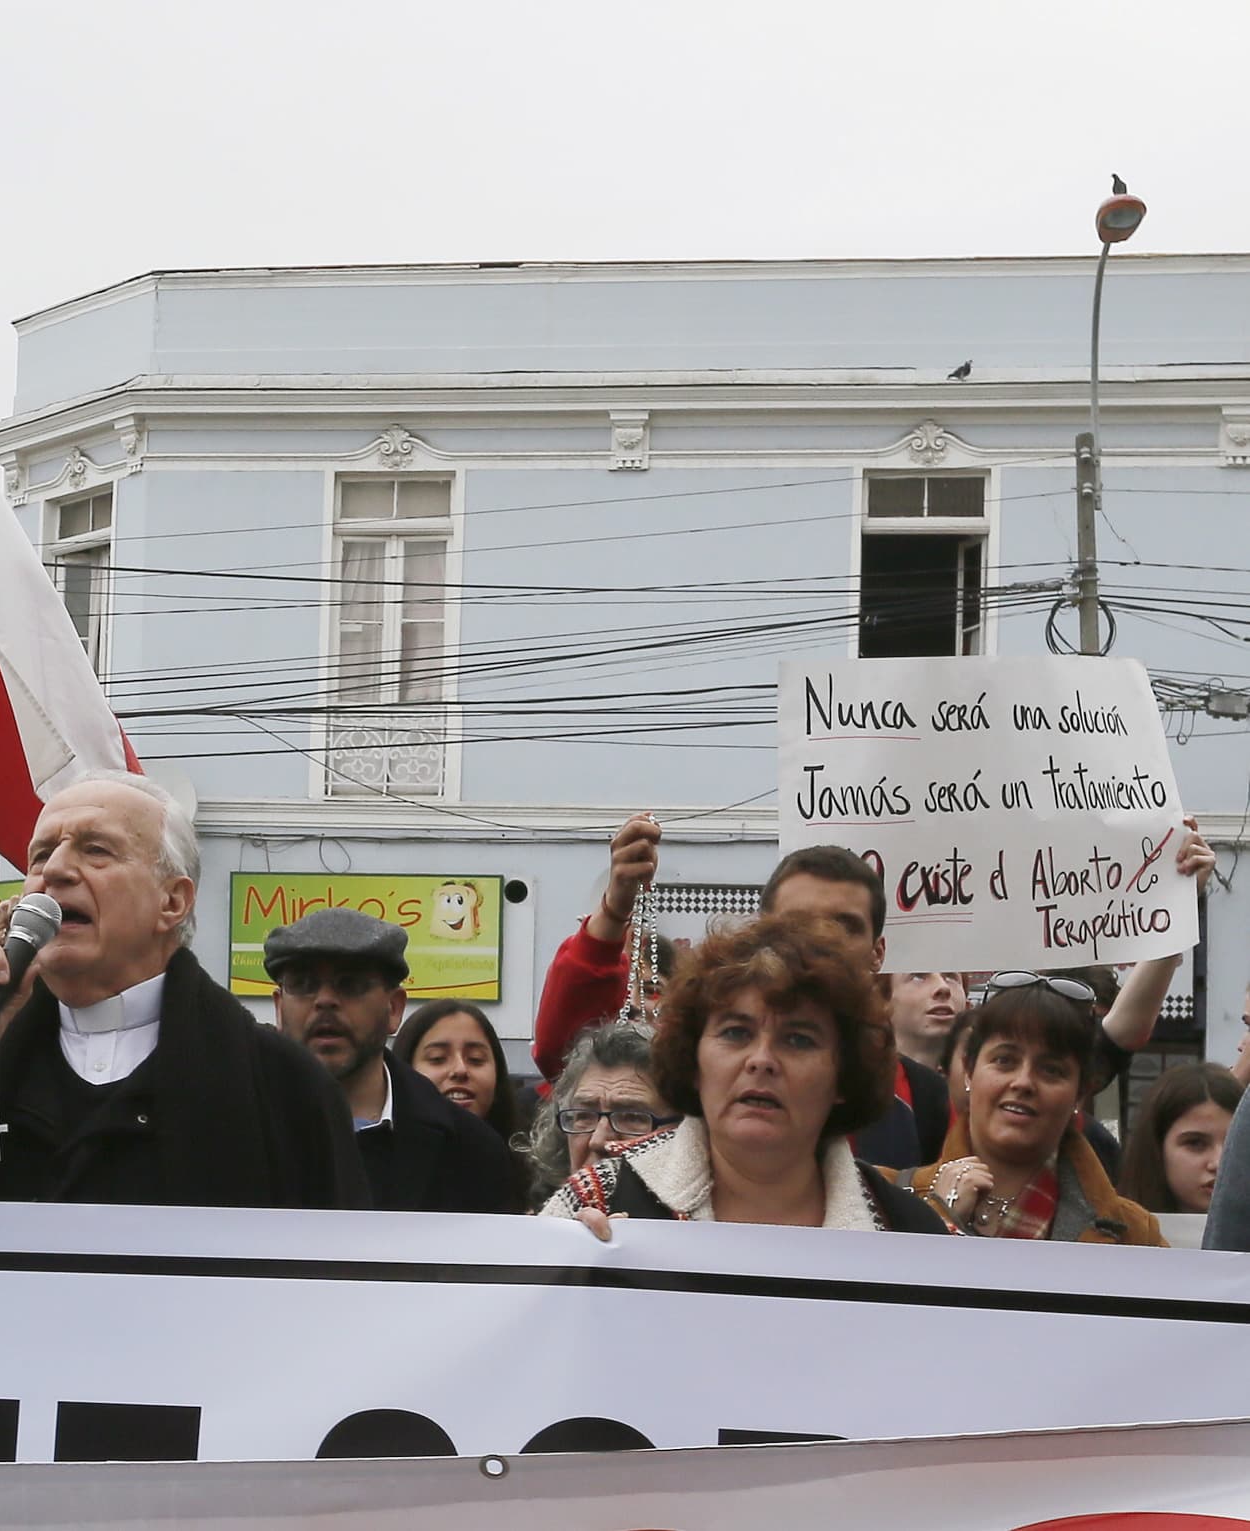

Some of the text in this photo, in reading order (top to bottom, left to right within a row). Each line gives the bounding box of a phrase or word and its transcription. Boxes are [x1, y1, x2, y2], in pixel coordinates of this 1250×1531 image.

[805, 673, 1129, 736] Nunca será una solución
[797, 755, 1167, 821] Jamás será un tratamiento
[896, 847, 974, 912] existe
[989, 850, 1009, 901] el
[1031, 846, 1122, 901] Aborto
[1036, 900, 1171, 960] Terapéutico
